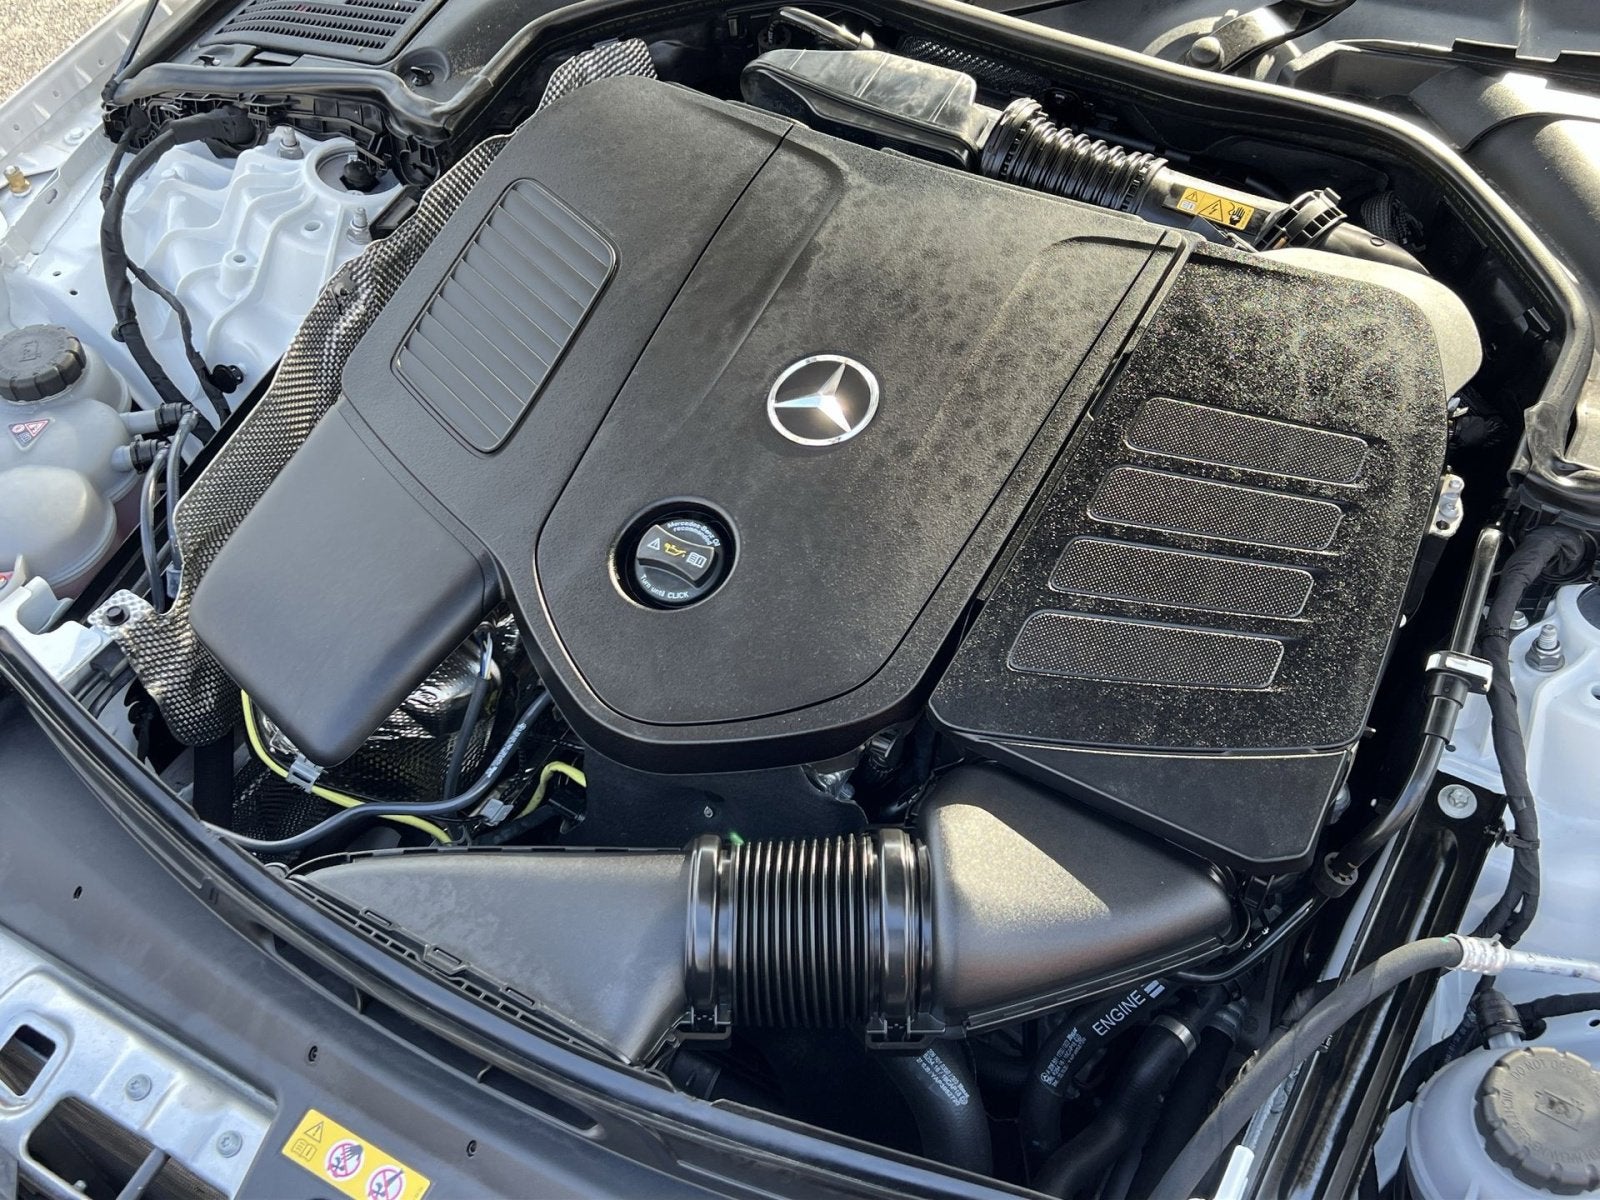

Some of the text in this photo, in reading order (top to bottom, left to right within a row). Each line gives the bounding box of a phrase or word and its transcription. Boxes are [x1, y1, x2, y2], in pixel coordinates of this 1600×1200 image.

[667, 520, 716, 539] Mercedes-Benz
[640, 574, 690, 599] Turn until CLICK
[1092, 990, 1146, 1036] ENGINE
[1511, 1067, 1525, 1080] DO
[1525, 1059, 1545, 1071] NOT
